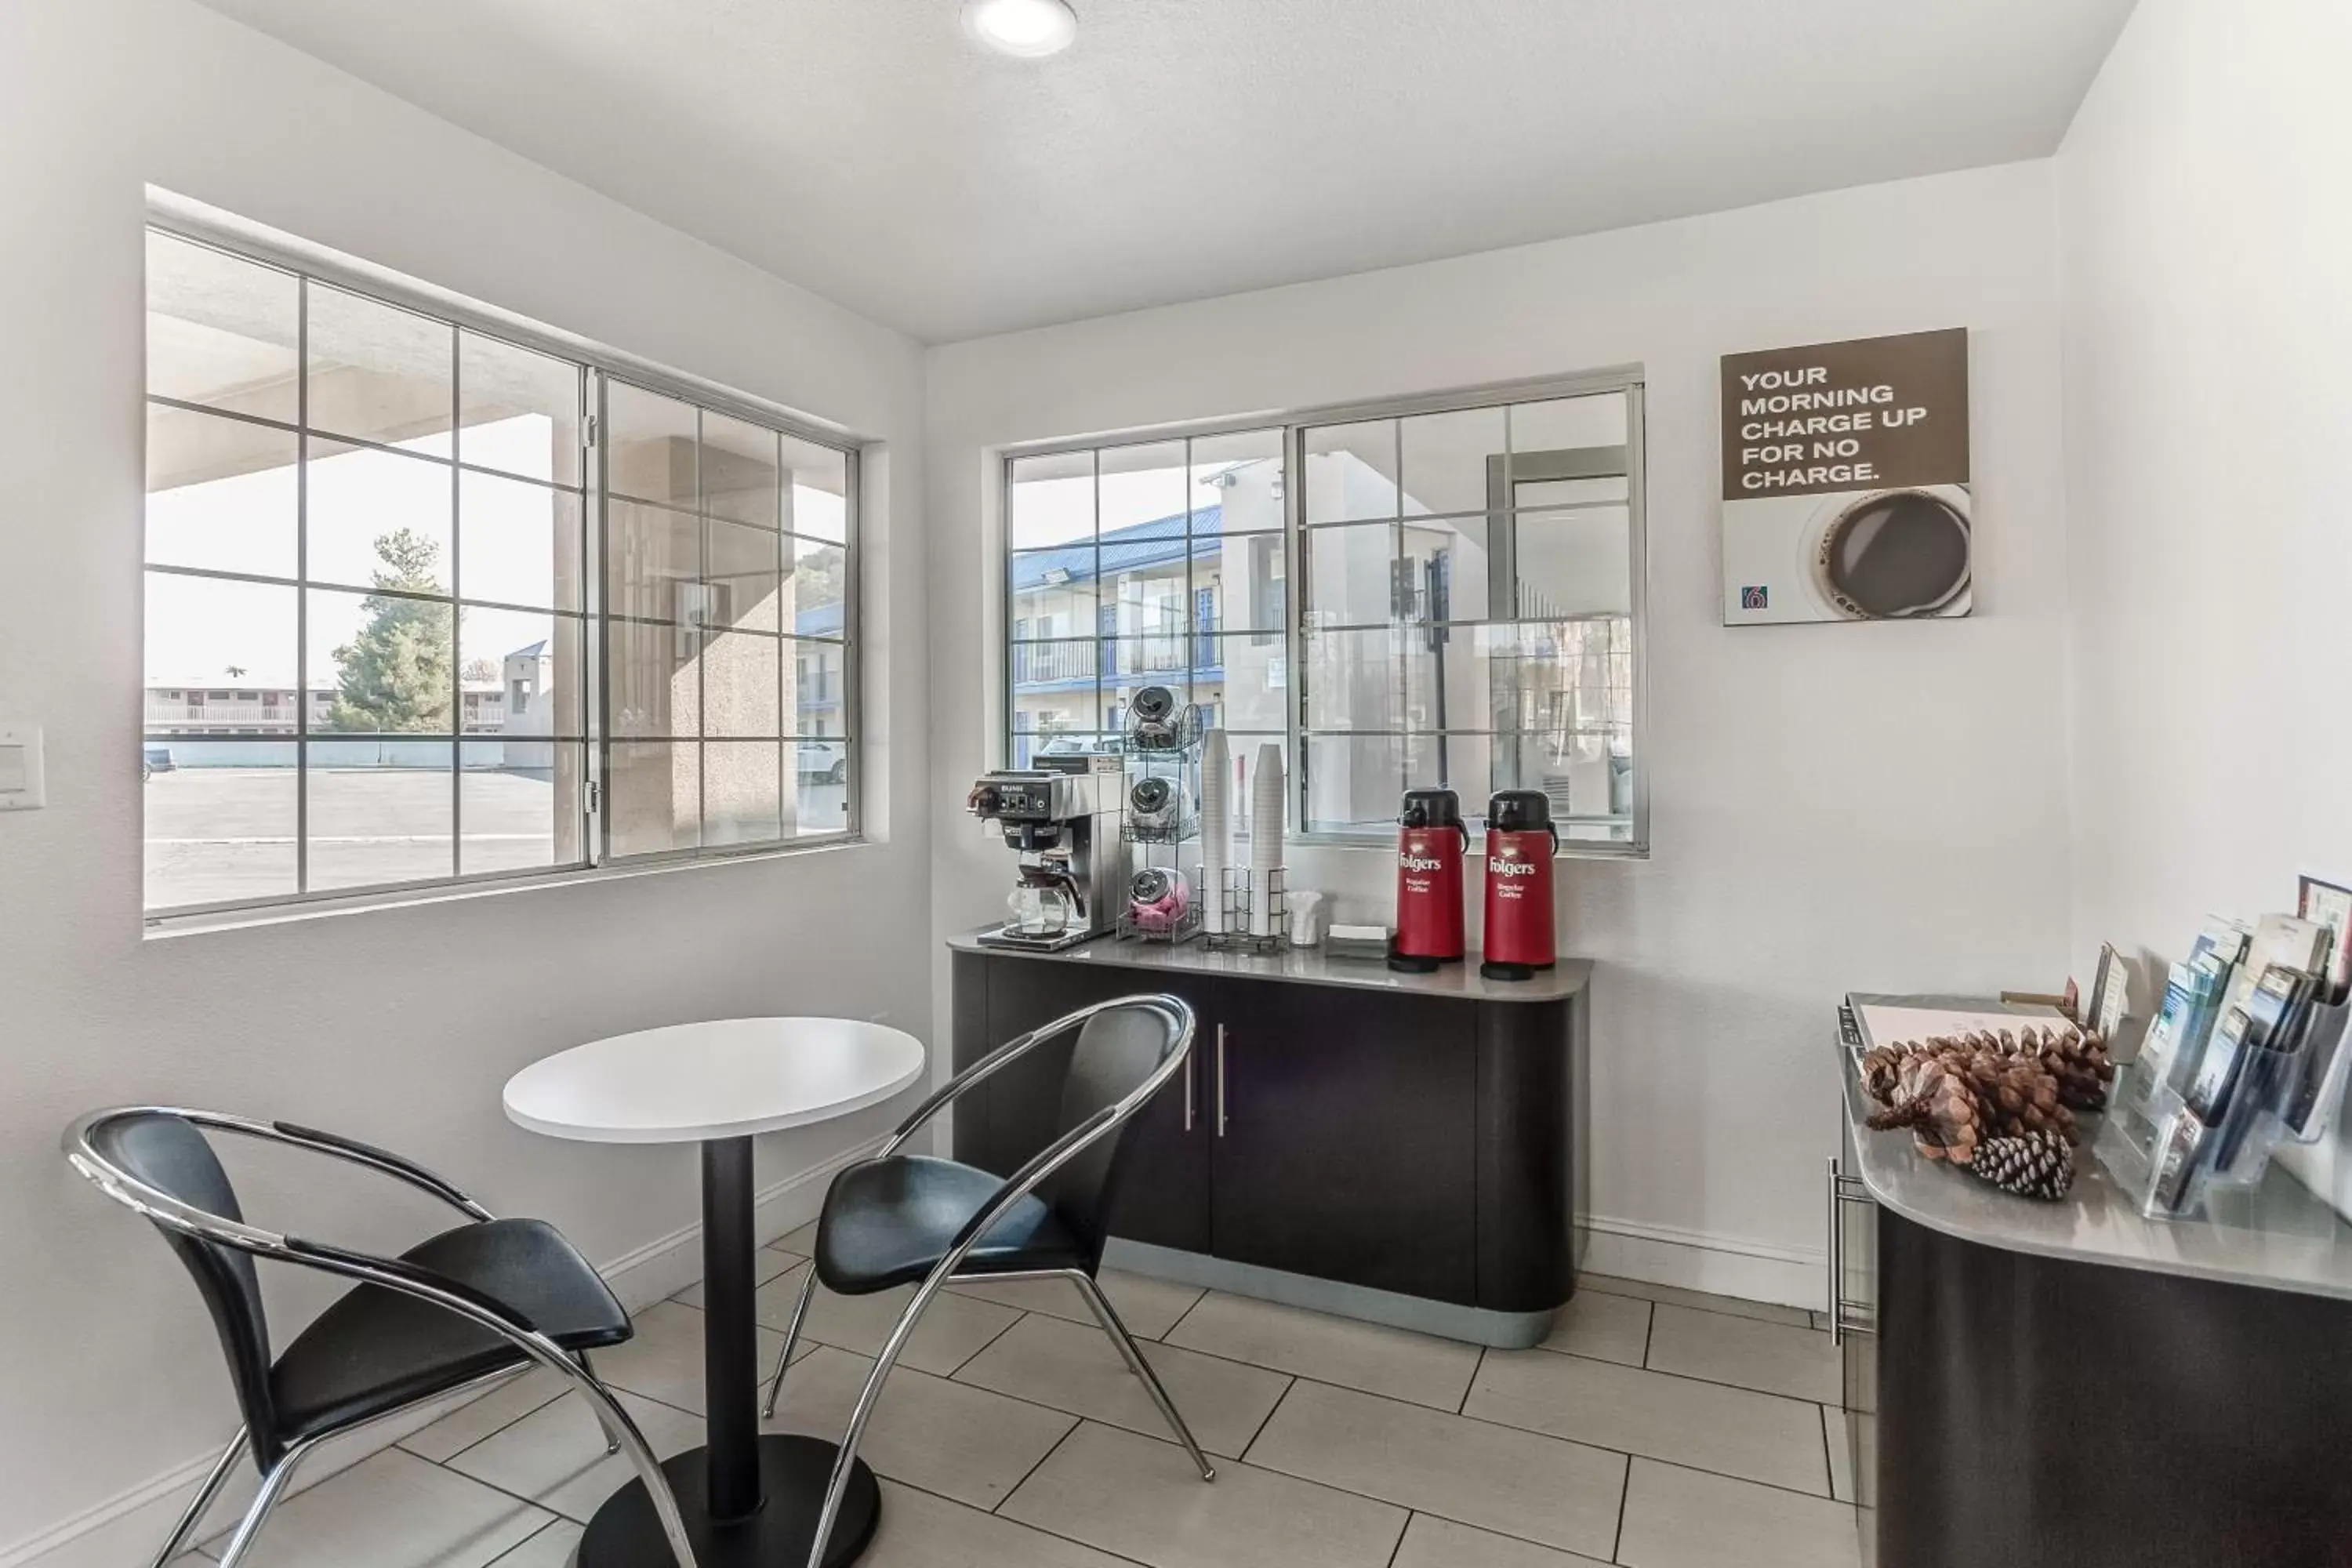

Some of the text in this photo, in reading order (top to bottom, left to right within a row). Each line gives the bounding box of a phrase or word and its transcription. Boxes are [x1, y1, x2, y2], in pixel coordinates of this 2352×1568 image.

[1740, 367, 1828, 391] YOUR
[1741, 385, 1893, 416] MORNING
[1741, 407, 1928, 441] CHARGE UP
[1742, 439, 1860, 465] FOR NO
[1741, 463, 1880, 490] CHARGE.
